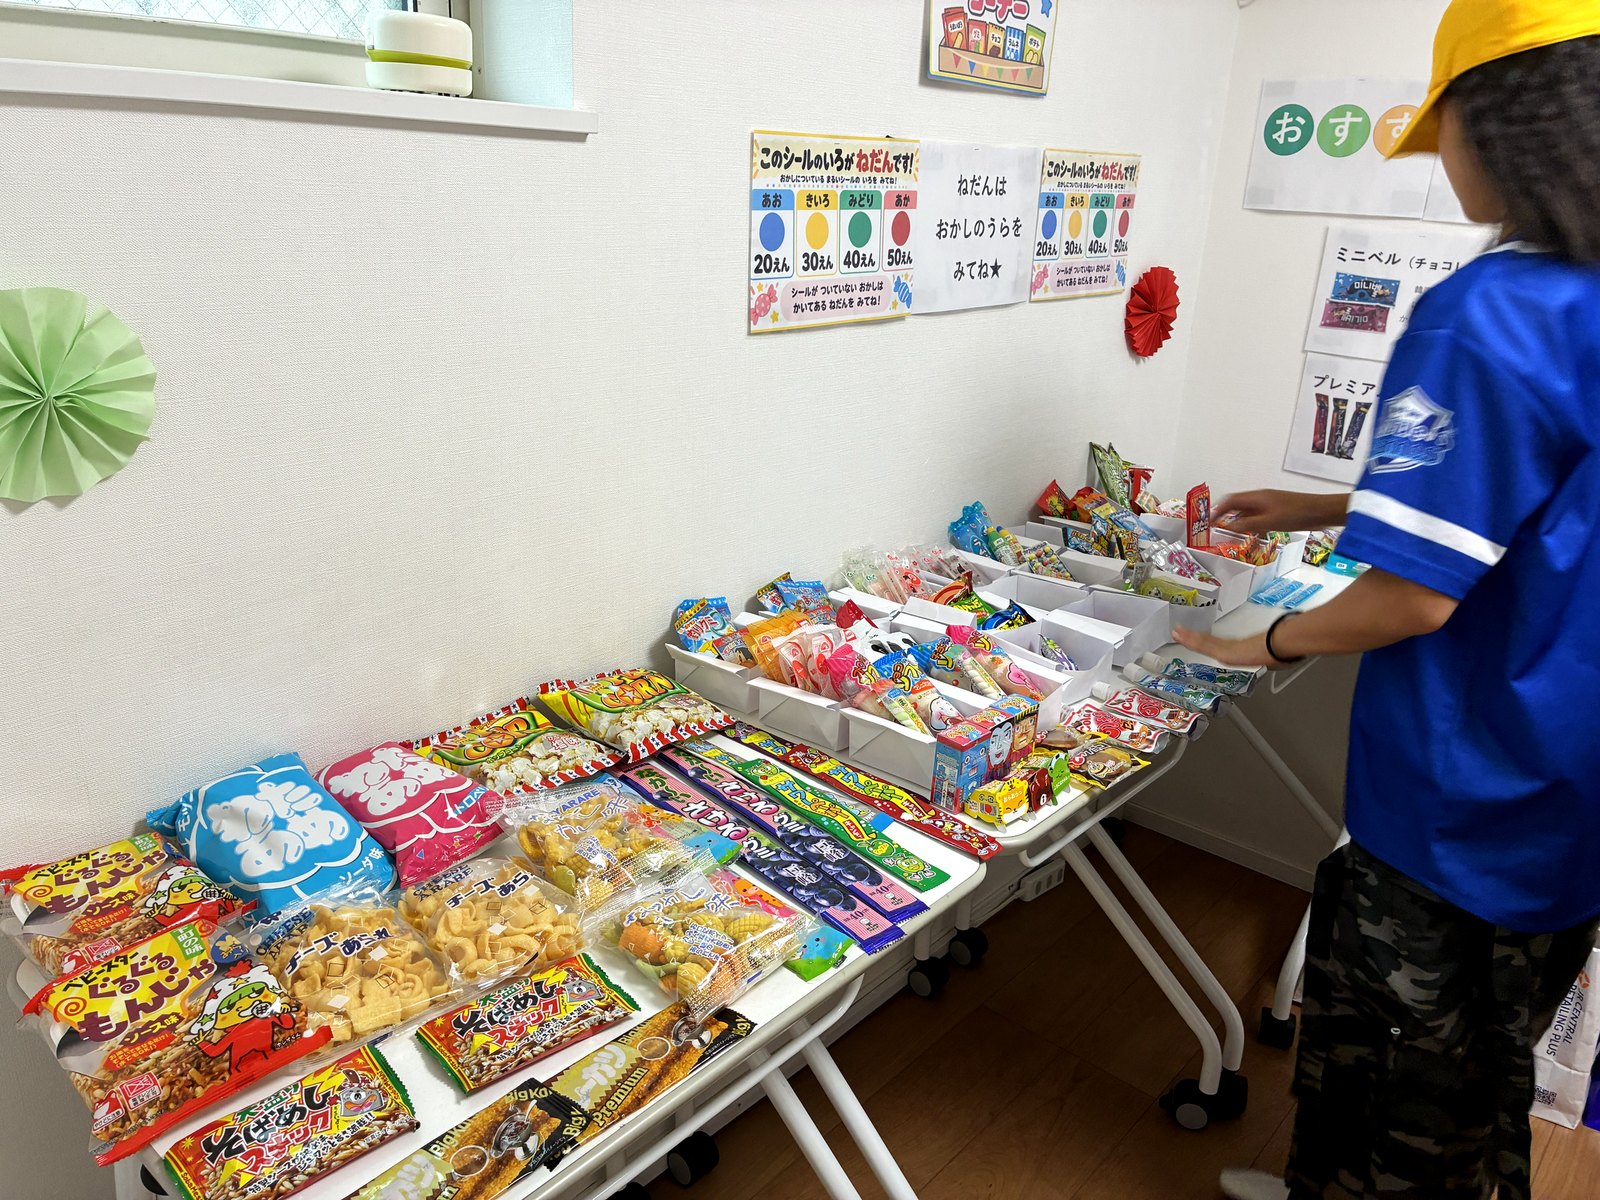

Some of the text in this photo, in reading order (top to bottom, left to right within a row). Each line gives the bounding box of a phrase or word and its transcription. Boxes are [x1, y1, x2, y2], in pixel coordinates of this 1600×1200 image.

[957, 174, 1007, 197] ねだんは
[761, 193, 782, 208] あお
[805, 193, 830, 208] きいろ
[848, 193, 874, 208] みどり
[894, 193, 910, 208] あか
[1045, 196, 1057, 207] あお
[1070, 196, 1085, 207] きいろ
[1094, 196, 1110, 208] みどり
[1122, 197, 1131, 208] あか
[935, 216, 1023, 239] おかしのうらを
[1036, 241, 1057, 257] 20えん
[1064, 240, 1083, 256] 30えん
[1088, 240, 1107, 255] 40えん
[1113, 238, 1128, 254] 50えん
[1336, 247, 1402, 266] ミニベル
[753, 254, 790, 274] 20えん
[801, 252, 834, 271] 30えん
[842, 249, 876, 269] 40えん
[886, 248, 913, 267] 50えん
[791, 281, 884, 298] シールが ついていない おかしは
[793, 302, 827, 314] かいてある
[829, 299, 855, 310] ねだんを
[601, 674, 675, 708] CORN
[31, 851, 100, 880] ベビースター
[54, 852, 132, 886] ぐるぐる
[338, 847, 385, 884] ソーダ味
[45, 850, 168, 913] もんじゃ
[87, 893, 135, 916] ソース味
[63, 952, 139, 992] ベビースター
[88, 952, 175, 999] ぐるぐる
[77, 958, 215, 1043] もんじゃ
[451, 980, 559, 1038] そばめし
[123, 1014, 179, 1044] ソース味
[486, 999, 561, 1046] スナック
[1562, 1002, 1583, 1044] CENTRAL
[1546, 1033, 1561, 1057] PLUS
[591, 1067, 649, 1127] Premium
[201, 1085, 332, 1166] そばめし
[240, 1110, 331, 1175] スナック
